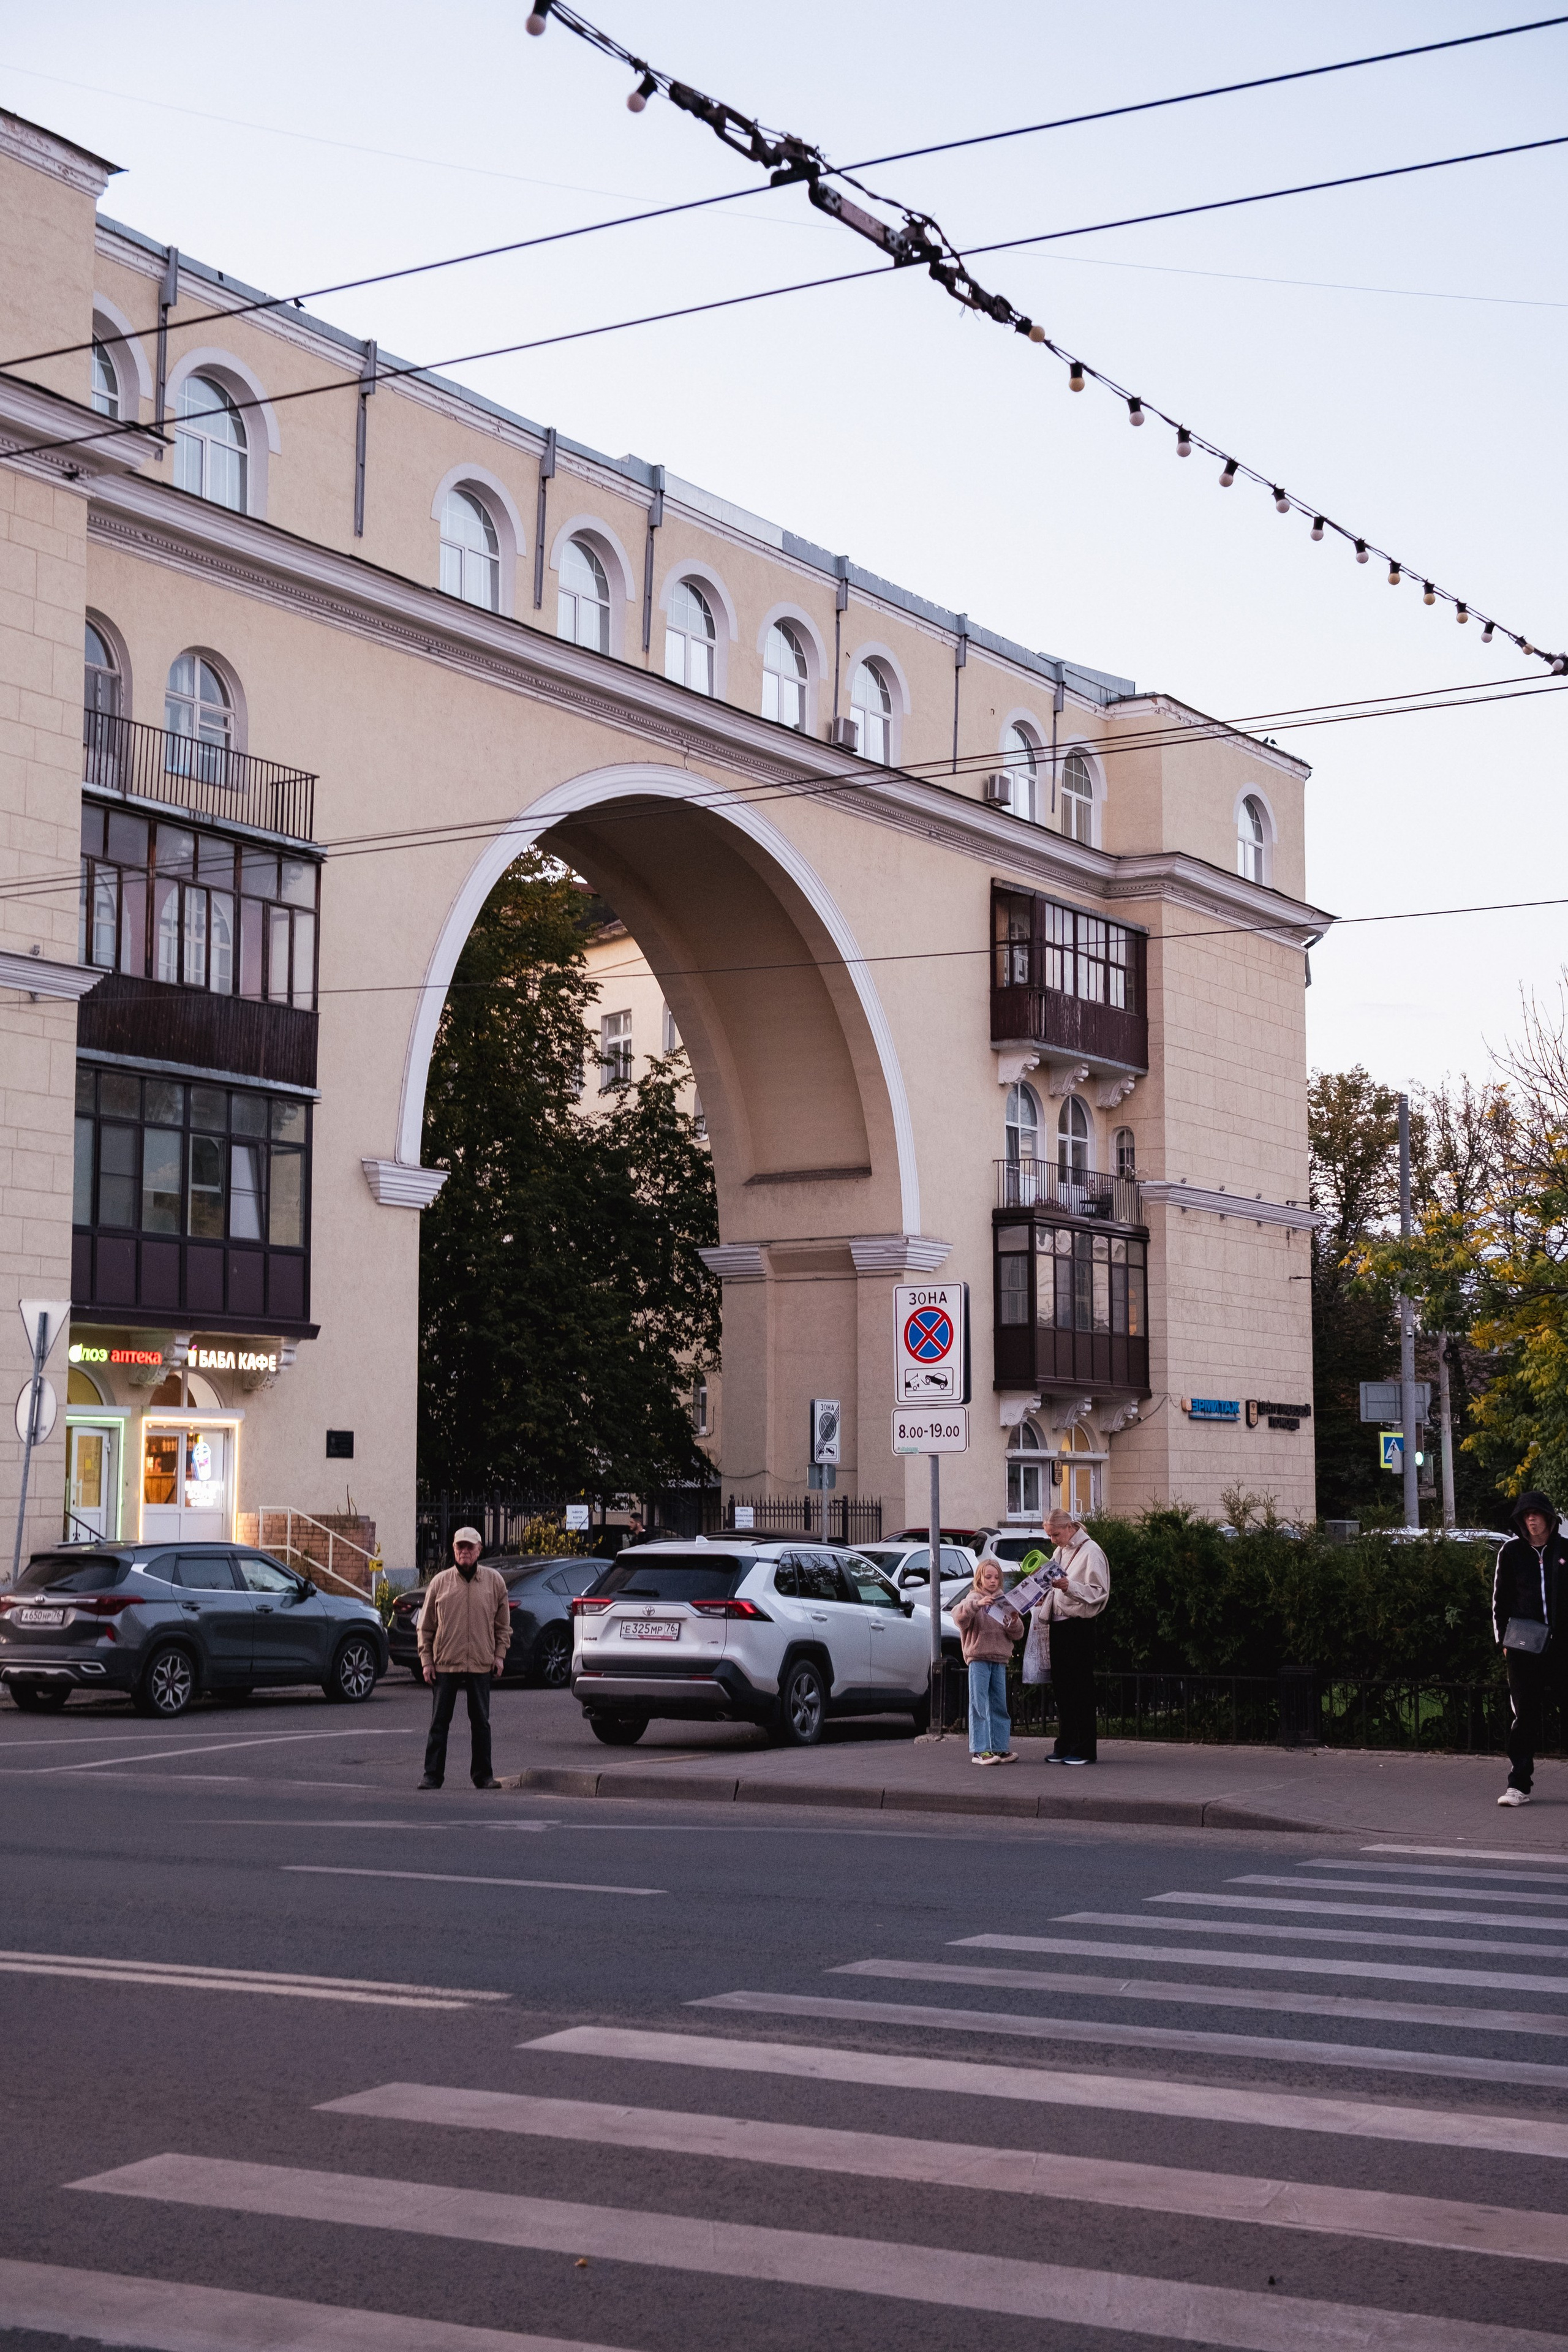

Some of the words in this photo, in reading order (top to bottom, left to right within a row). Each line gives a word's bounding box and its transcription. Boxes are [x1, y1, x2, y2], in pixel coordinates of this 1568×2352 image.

[908, 1291, 948, 1305] ЗОНА
[111, 1349, 162, 1365] аптека
[199, 1350, 236, 1369] БАБЛ
[238, 1352, 276, 1371] КАФЕ
[1191, 1398, 1240, 1414] ЭРМИТАЖ
[899, 1423, 960, 1439] 8.00-19.00
